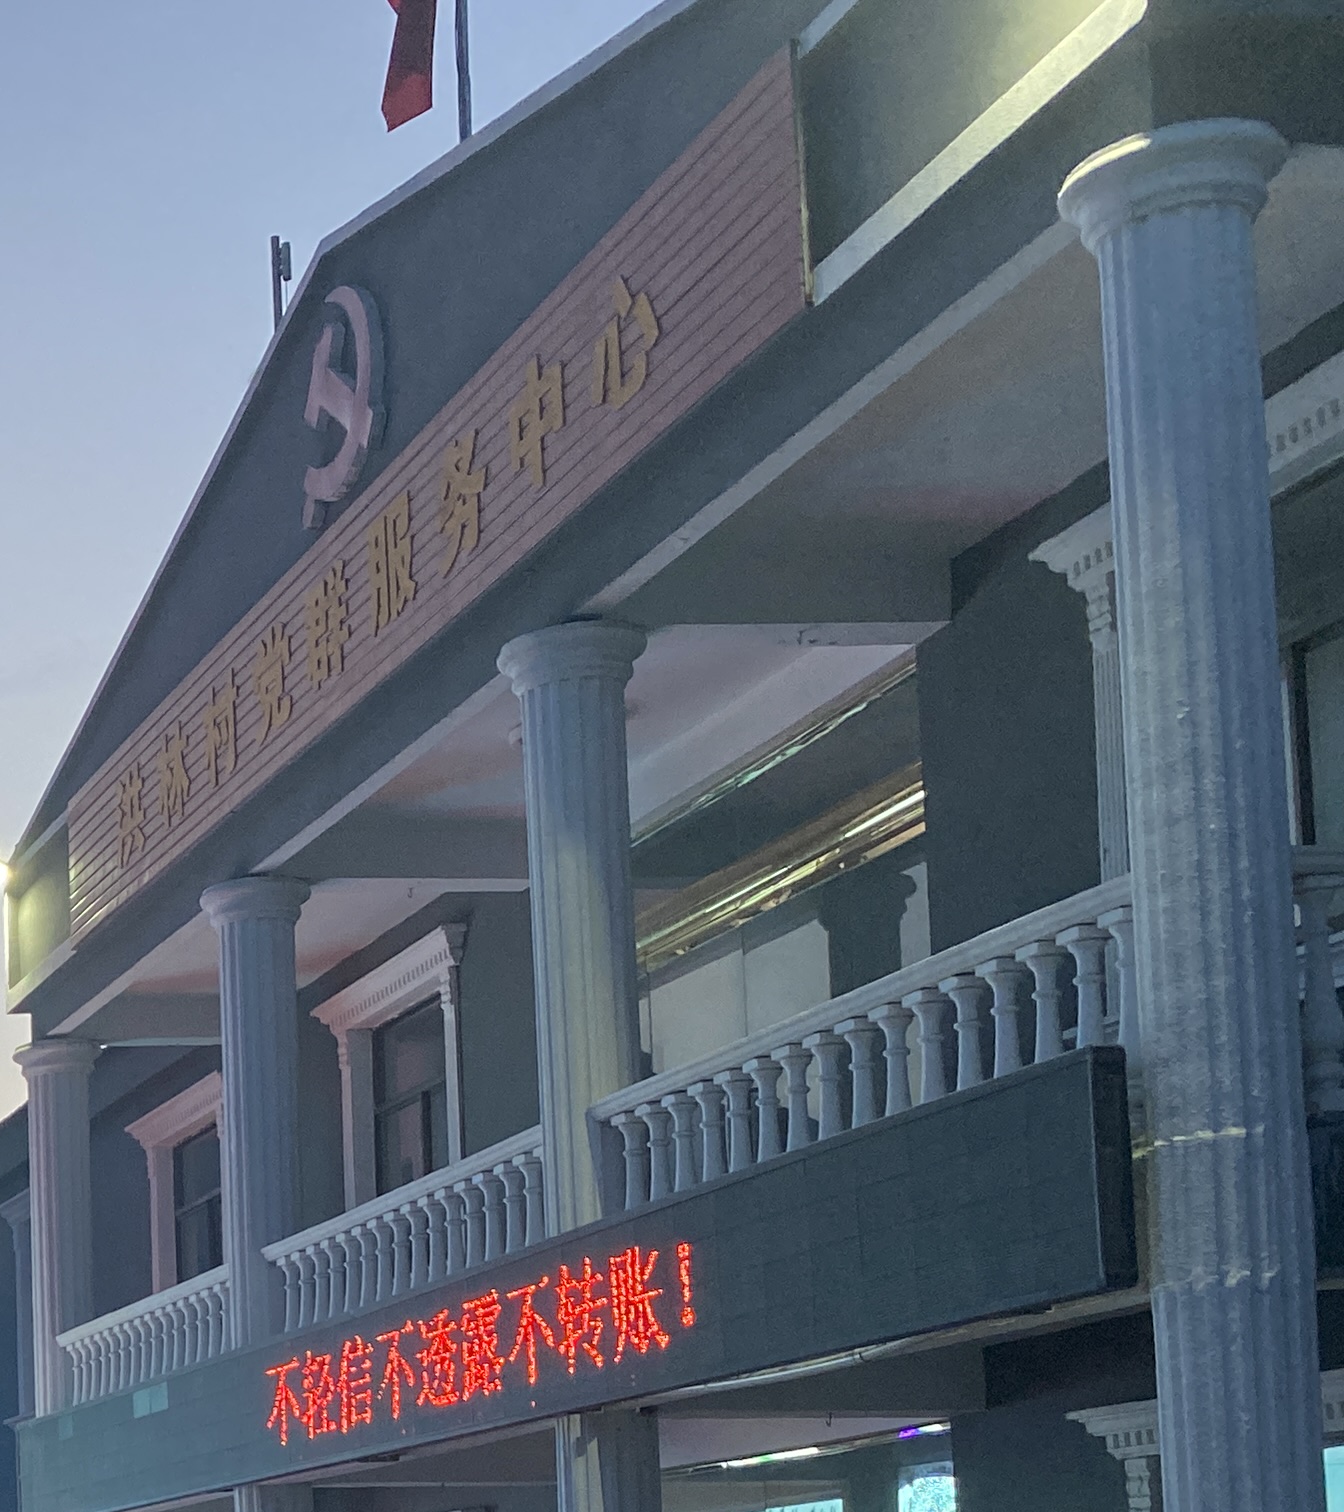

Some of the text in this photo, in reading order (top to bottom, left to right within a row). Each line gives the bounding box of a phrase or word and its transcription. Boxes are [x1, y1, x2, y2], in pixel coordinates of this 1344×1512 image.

[115, 274, 662, 870] 洪林村党群服务中心
